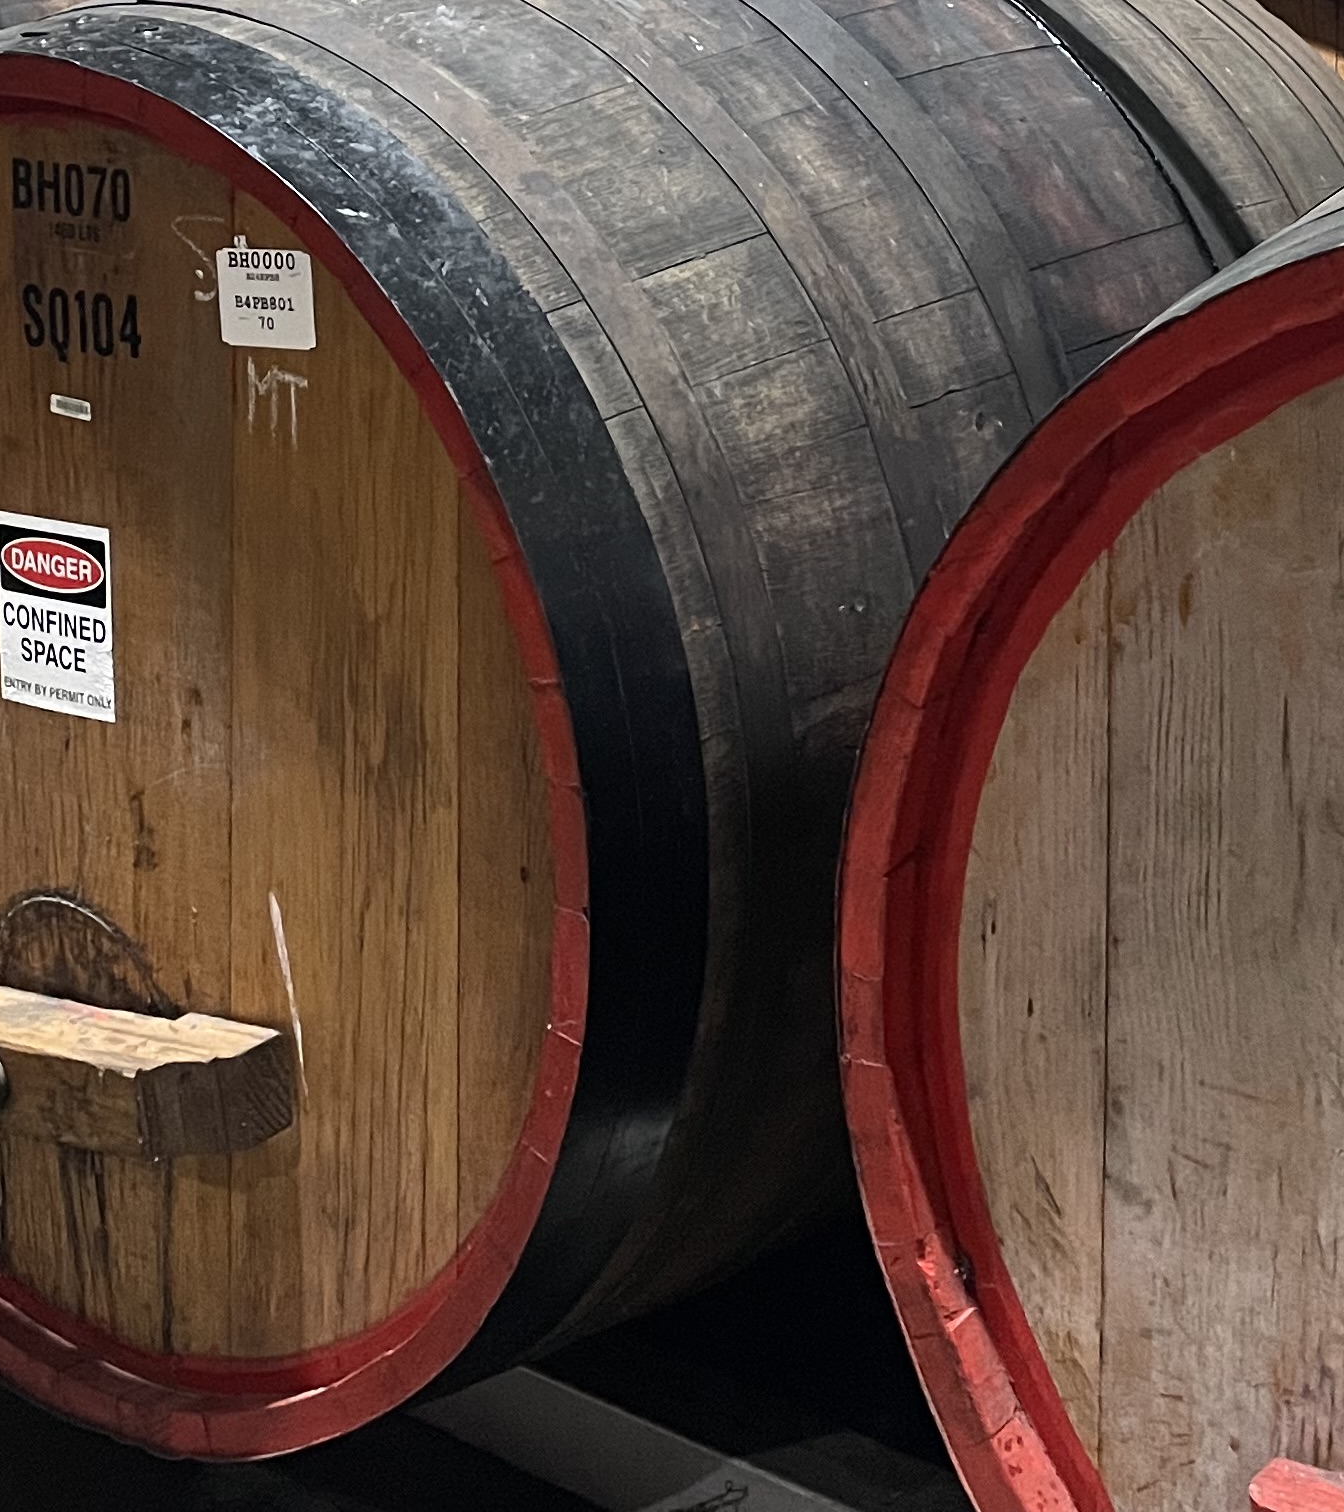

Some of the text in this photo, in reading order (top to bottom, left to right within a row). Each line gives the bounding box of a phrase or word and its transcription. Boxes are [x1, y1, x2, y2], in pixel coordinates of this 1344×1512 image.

[12, 158, 131, 222] BH070
[228, 251, 296, 270] BH0000
[235, 295, 294, 312] B4PB801
[22, 284, 142, 362] SQ104
[258, 316, 275, 330] 70
[247, 355, 308, 449] MT
[10, 547, 93, 583] DANGER
[3, 601, 107, 644] CONFINED
[21, 637, 87, 673] SPACE
[4, 675, 113, 709] ENTRY BY PERMIT ONLY
